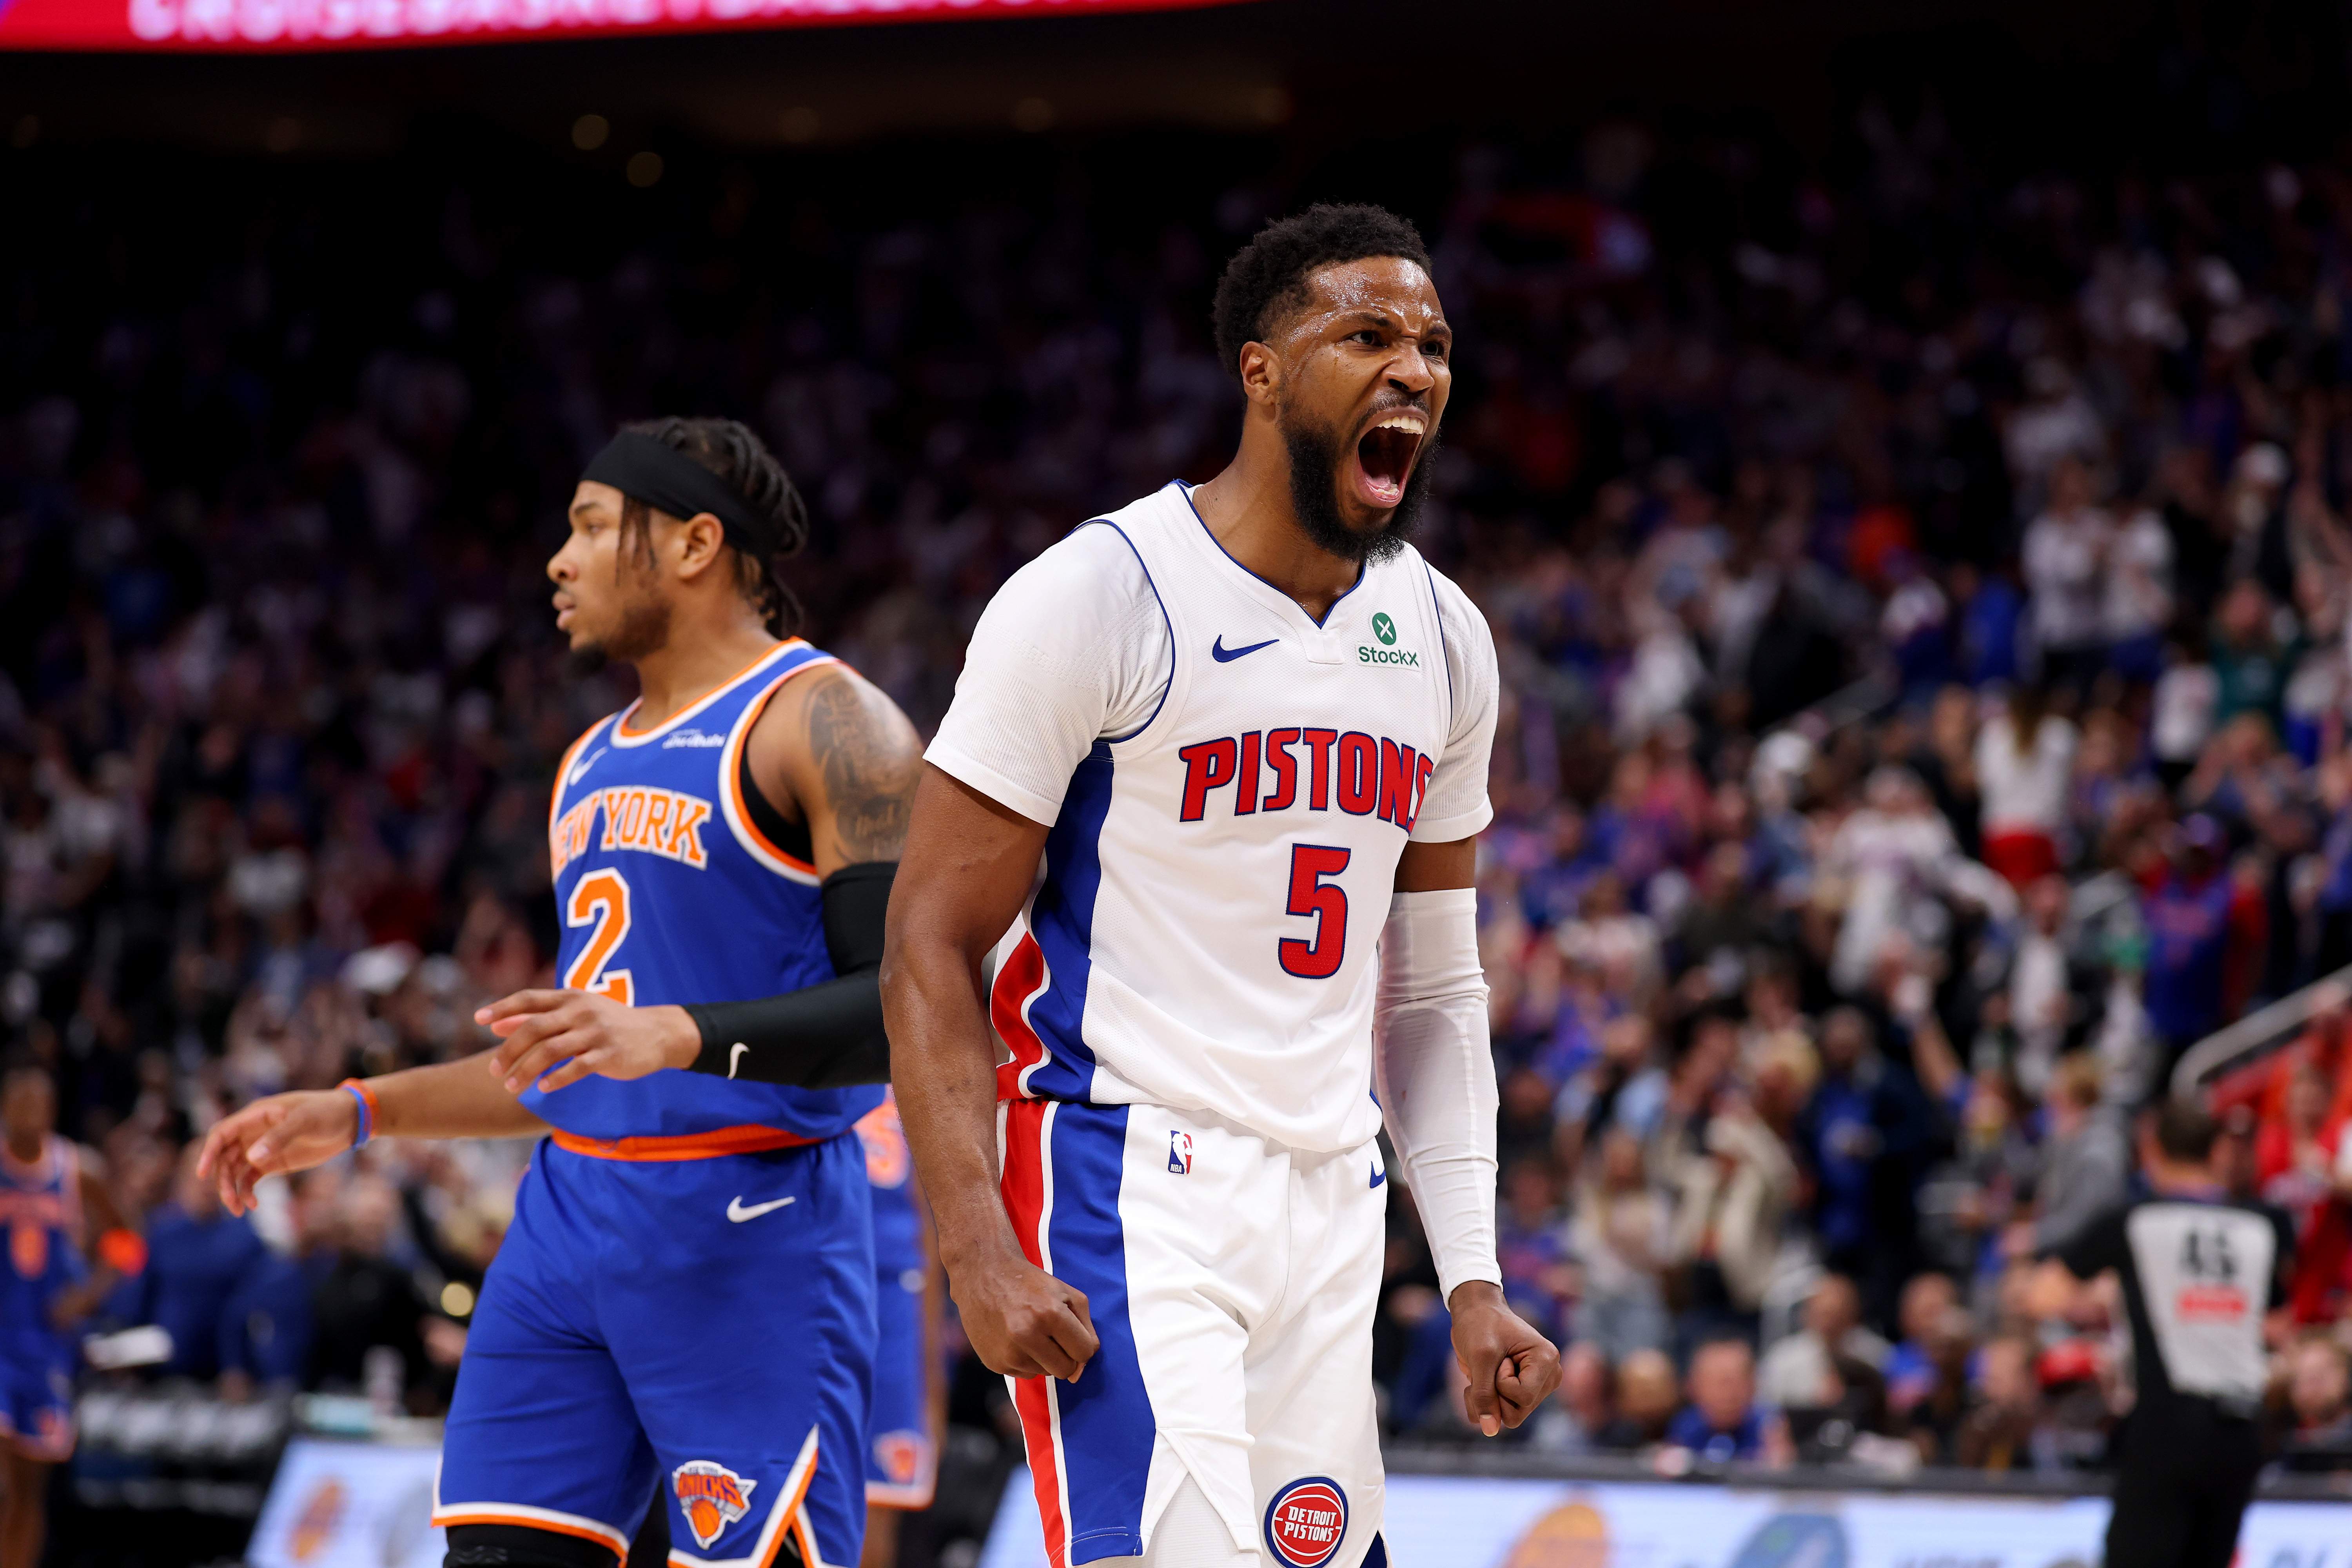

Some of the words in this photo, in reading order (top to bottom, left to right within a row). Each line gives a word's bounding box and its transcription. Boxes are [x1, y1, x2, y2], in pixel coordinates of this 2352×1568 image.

[1358, 646, 1419, 668] StockX
[1178, 727, 1434, 837] PISTONS
[549, 788, 604, 885] EW
[600, 785, 713, 872] YORK
[564, 866, 635, 1007] 2
[1278, 843, 1351, 979] 5
[1170, 1163, 1182, 1173] NBA
[1284, 1521, 1334, 1542] PISTONS
[1288, 1506, 1337, 1526] DETROIT
